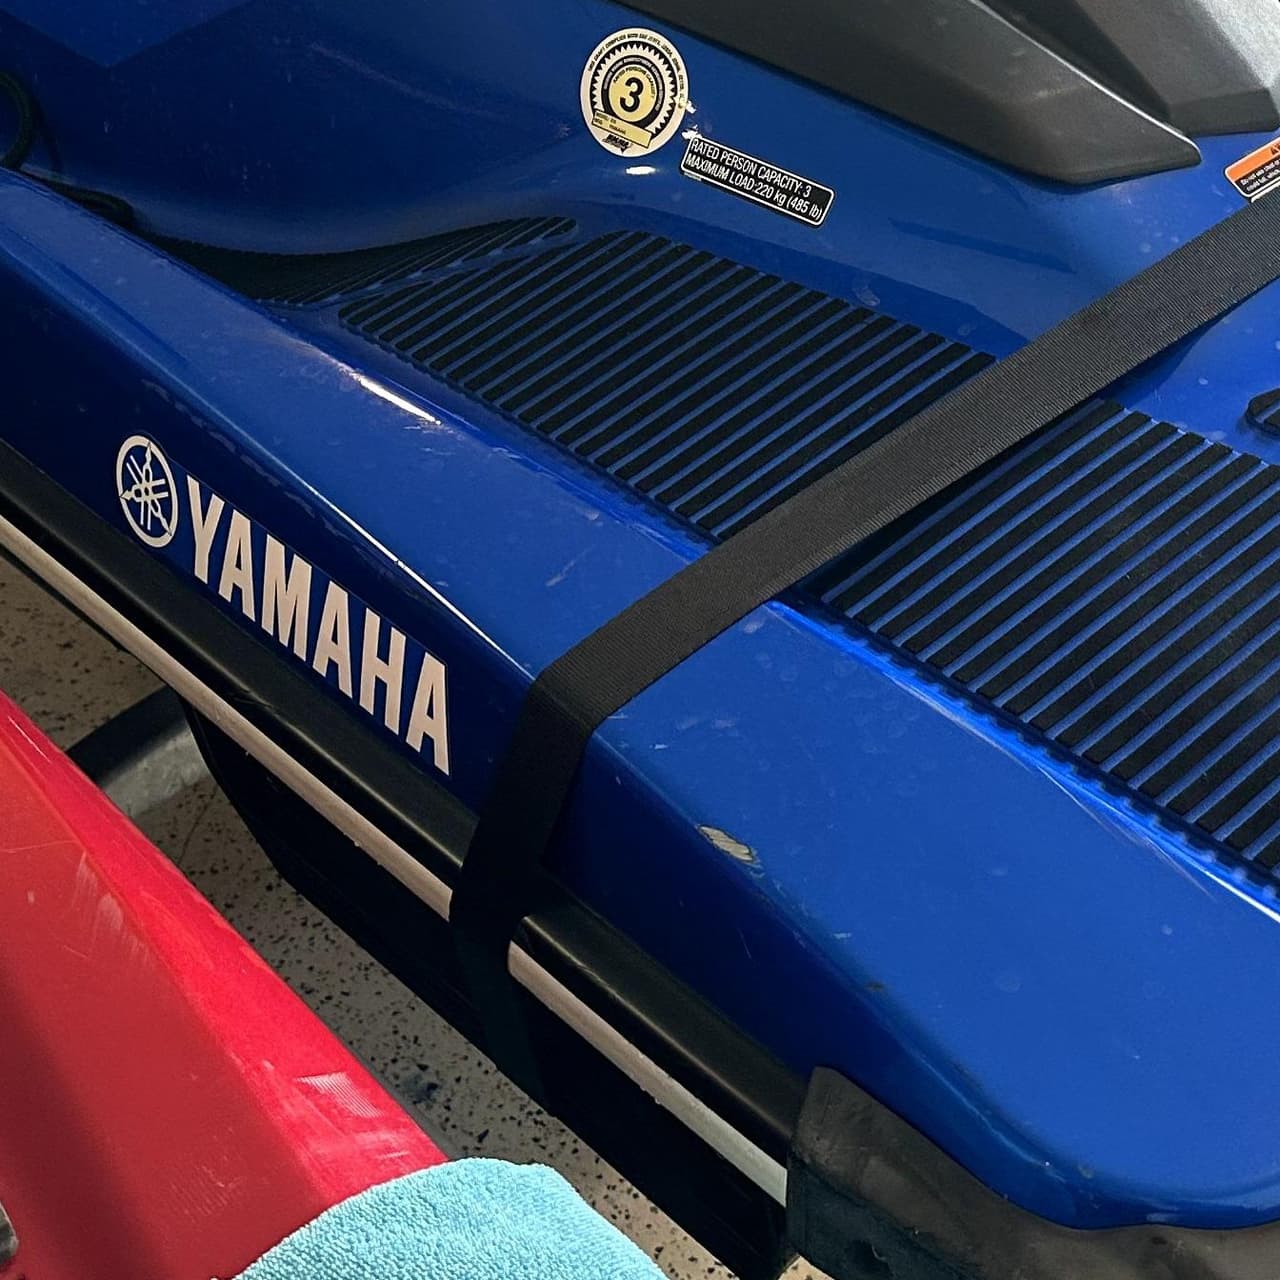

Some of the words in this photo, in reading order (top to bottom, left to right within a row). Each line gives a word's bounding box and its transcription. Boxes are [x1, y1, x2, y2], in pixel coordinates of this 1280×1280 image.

[619, 77, 644, 113] 3
[685, 153, 730, 181] MAXIMUM
[774, 189, 788, 207] kg
[786, 195, 809, 214] (485
[808, 204, 823, 221] lb)
[690, 138, 720, 160] RATED
[720, 150, 758, 176] PERSON
[757, 166, 804, 195] CAPACITY:
[803, 186, 812, 198] 3
[187, 474, 450, 777] YAMAHA
